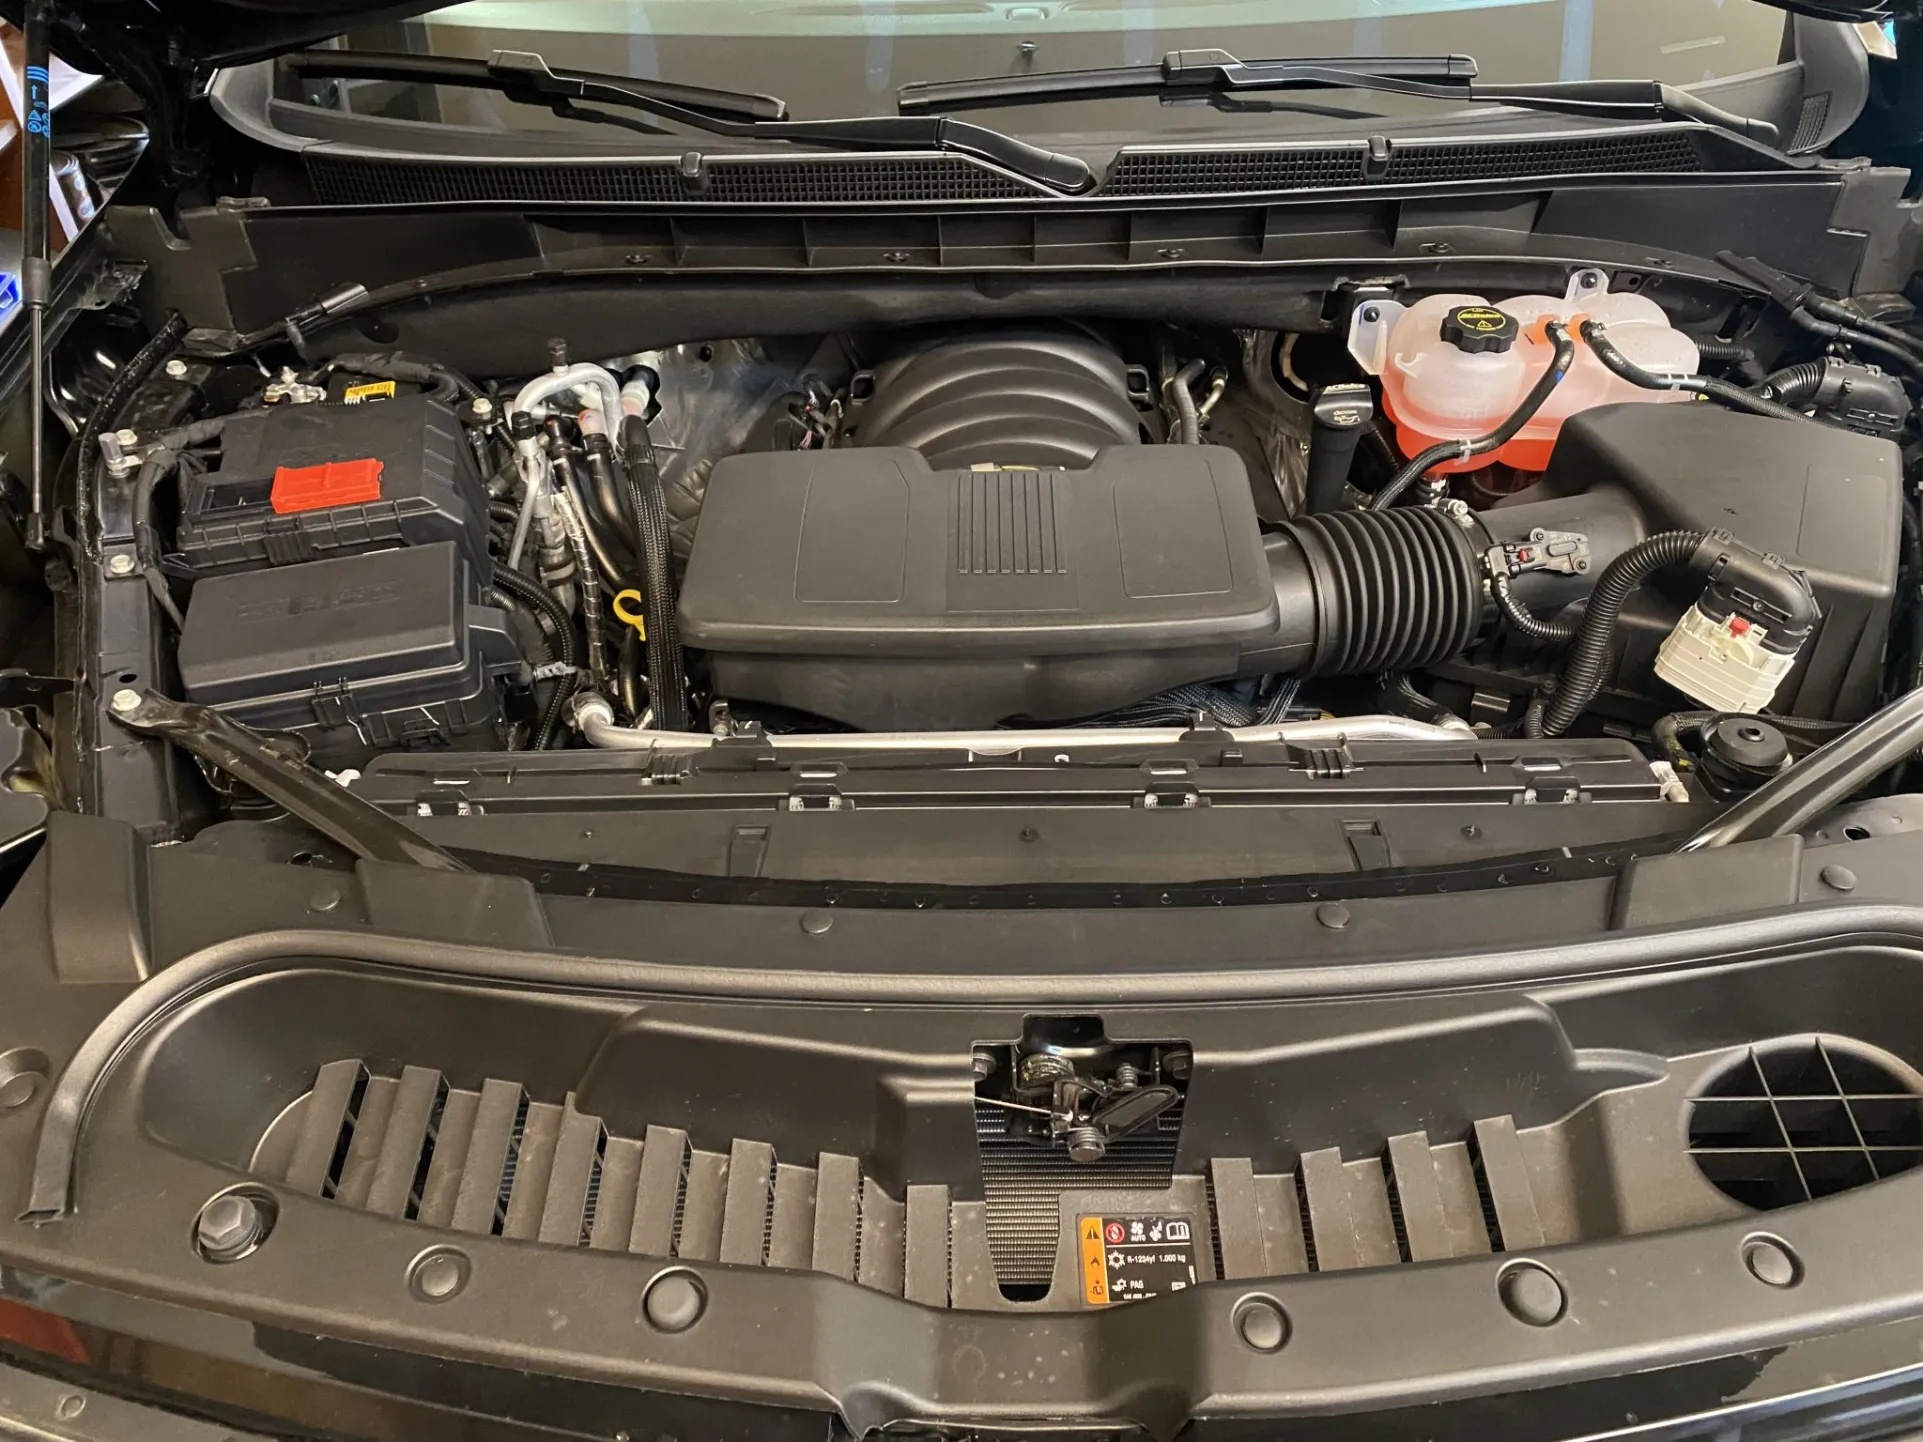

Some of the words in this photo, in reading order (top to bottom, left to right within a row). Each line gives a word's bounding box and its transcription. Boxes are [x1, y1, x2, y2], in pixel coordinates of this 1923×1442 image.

[1131, 1234, 1146, 1242] AUTO
[1127, 1254, 1156, 1264] R-1234yf
[1159, 1254, 1177, 1263] 1.000
[1177, 1254, 1186, 1263] kg
[1130, 1279, 1144, 1289] PAG
